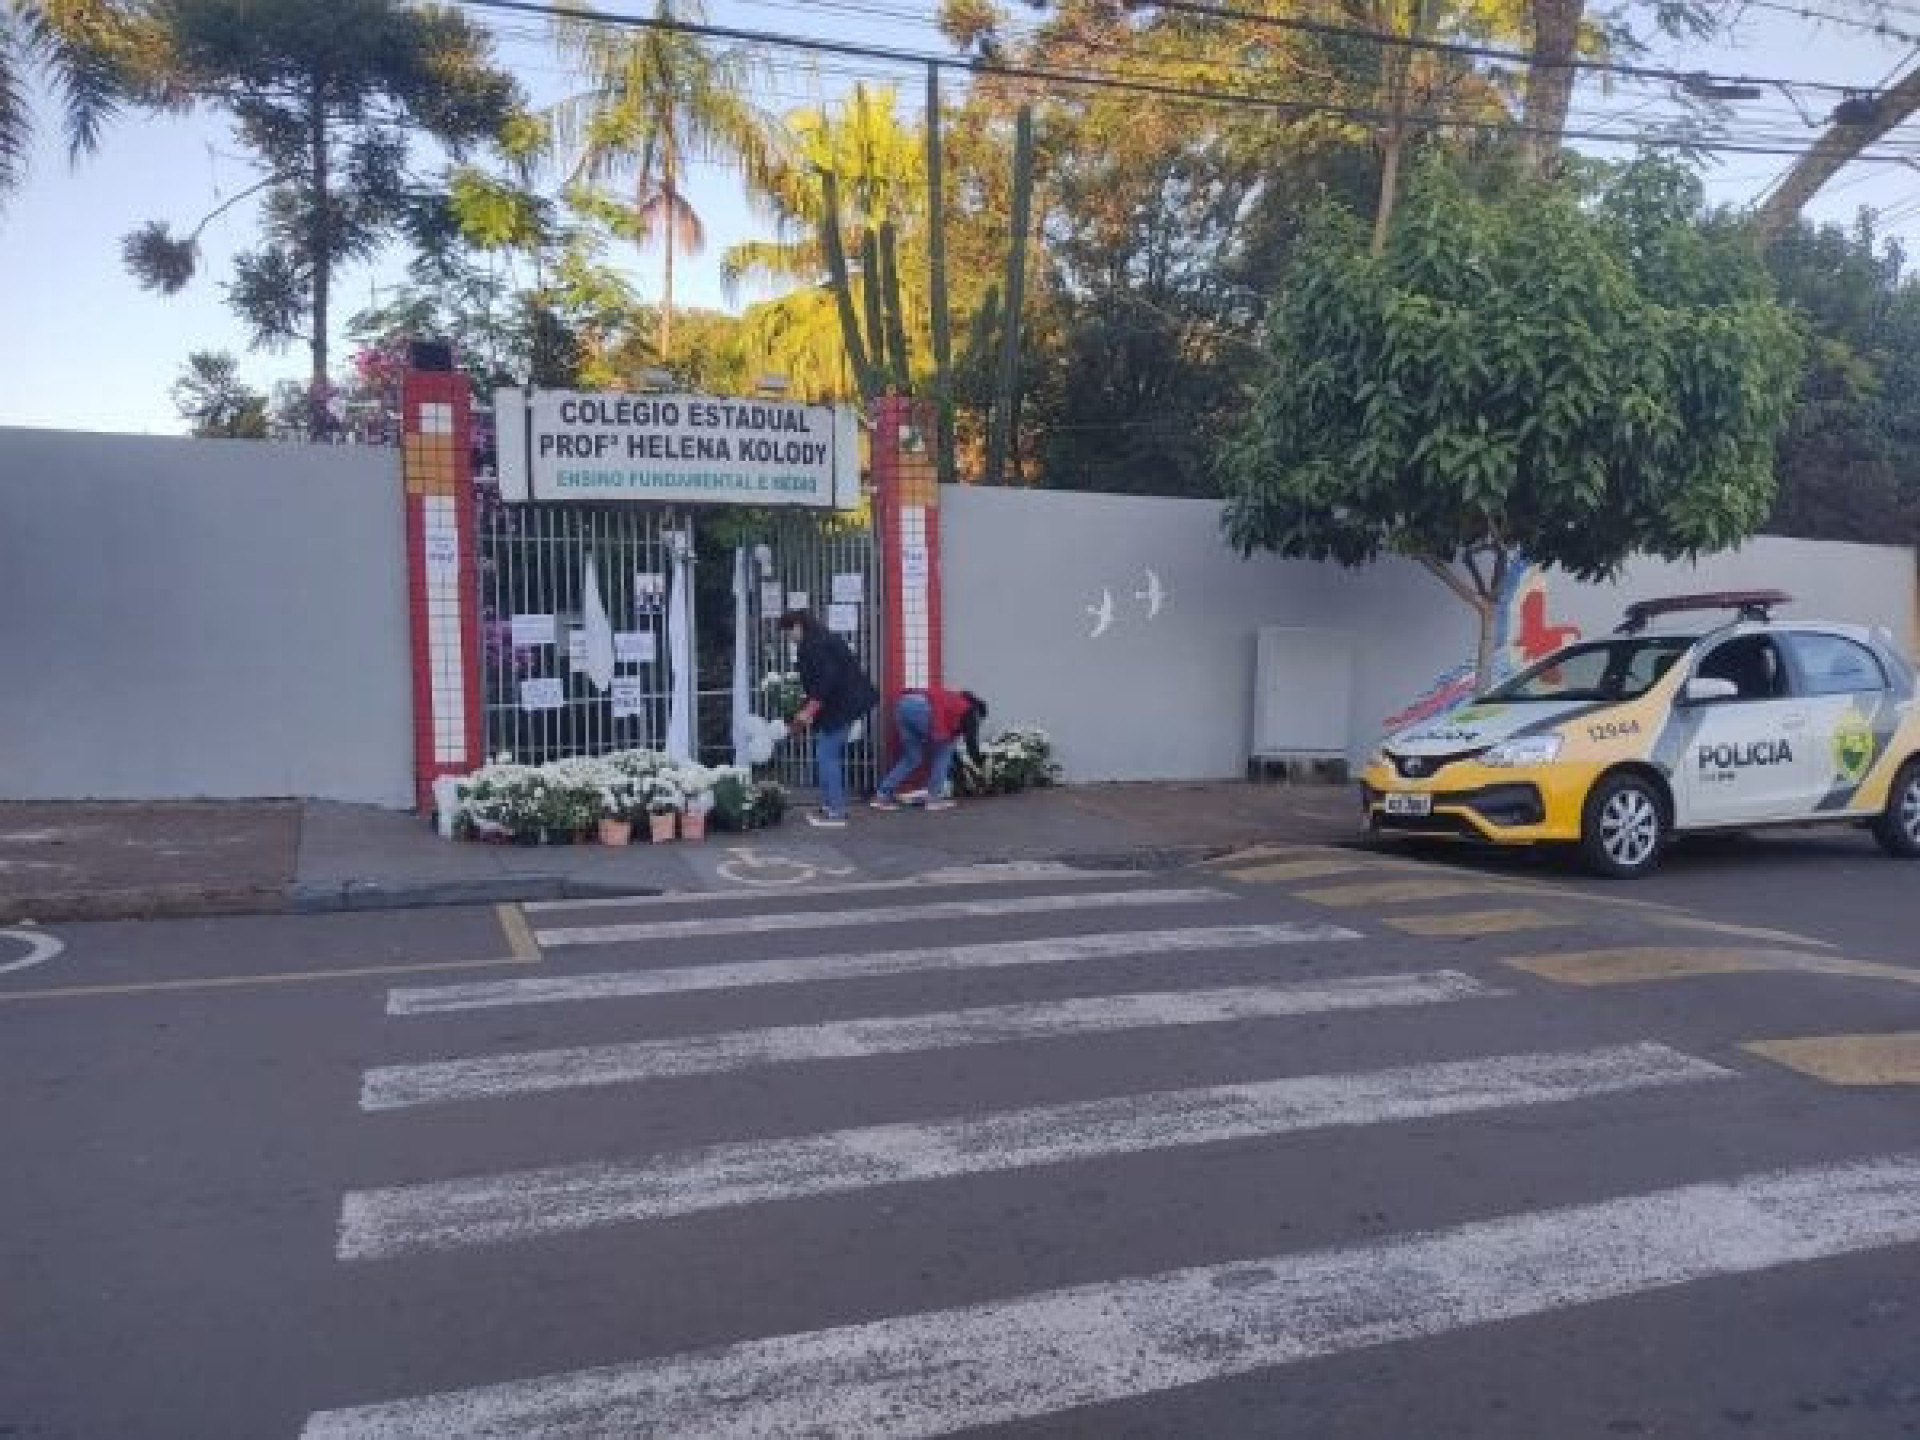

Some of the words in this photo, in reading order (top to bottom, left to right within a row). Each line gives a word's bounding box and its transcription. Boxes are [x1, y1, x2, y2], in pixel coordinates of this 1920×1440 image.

[560, 396, 680, 427] COLÉGIO
[688, 402, 811, 433] ESTADUAL
[627, 434, 731, 462] HELENA
[739, 439, 827, 467] KOLODY
[556, 470, 623, 488] ENSINO
[629, 471, 751, 491] FUNDAMENTAL
